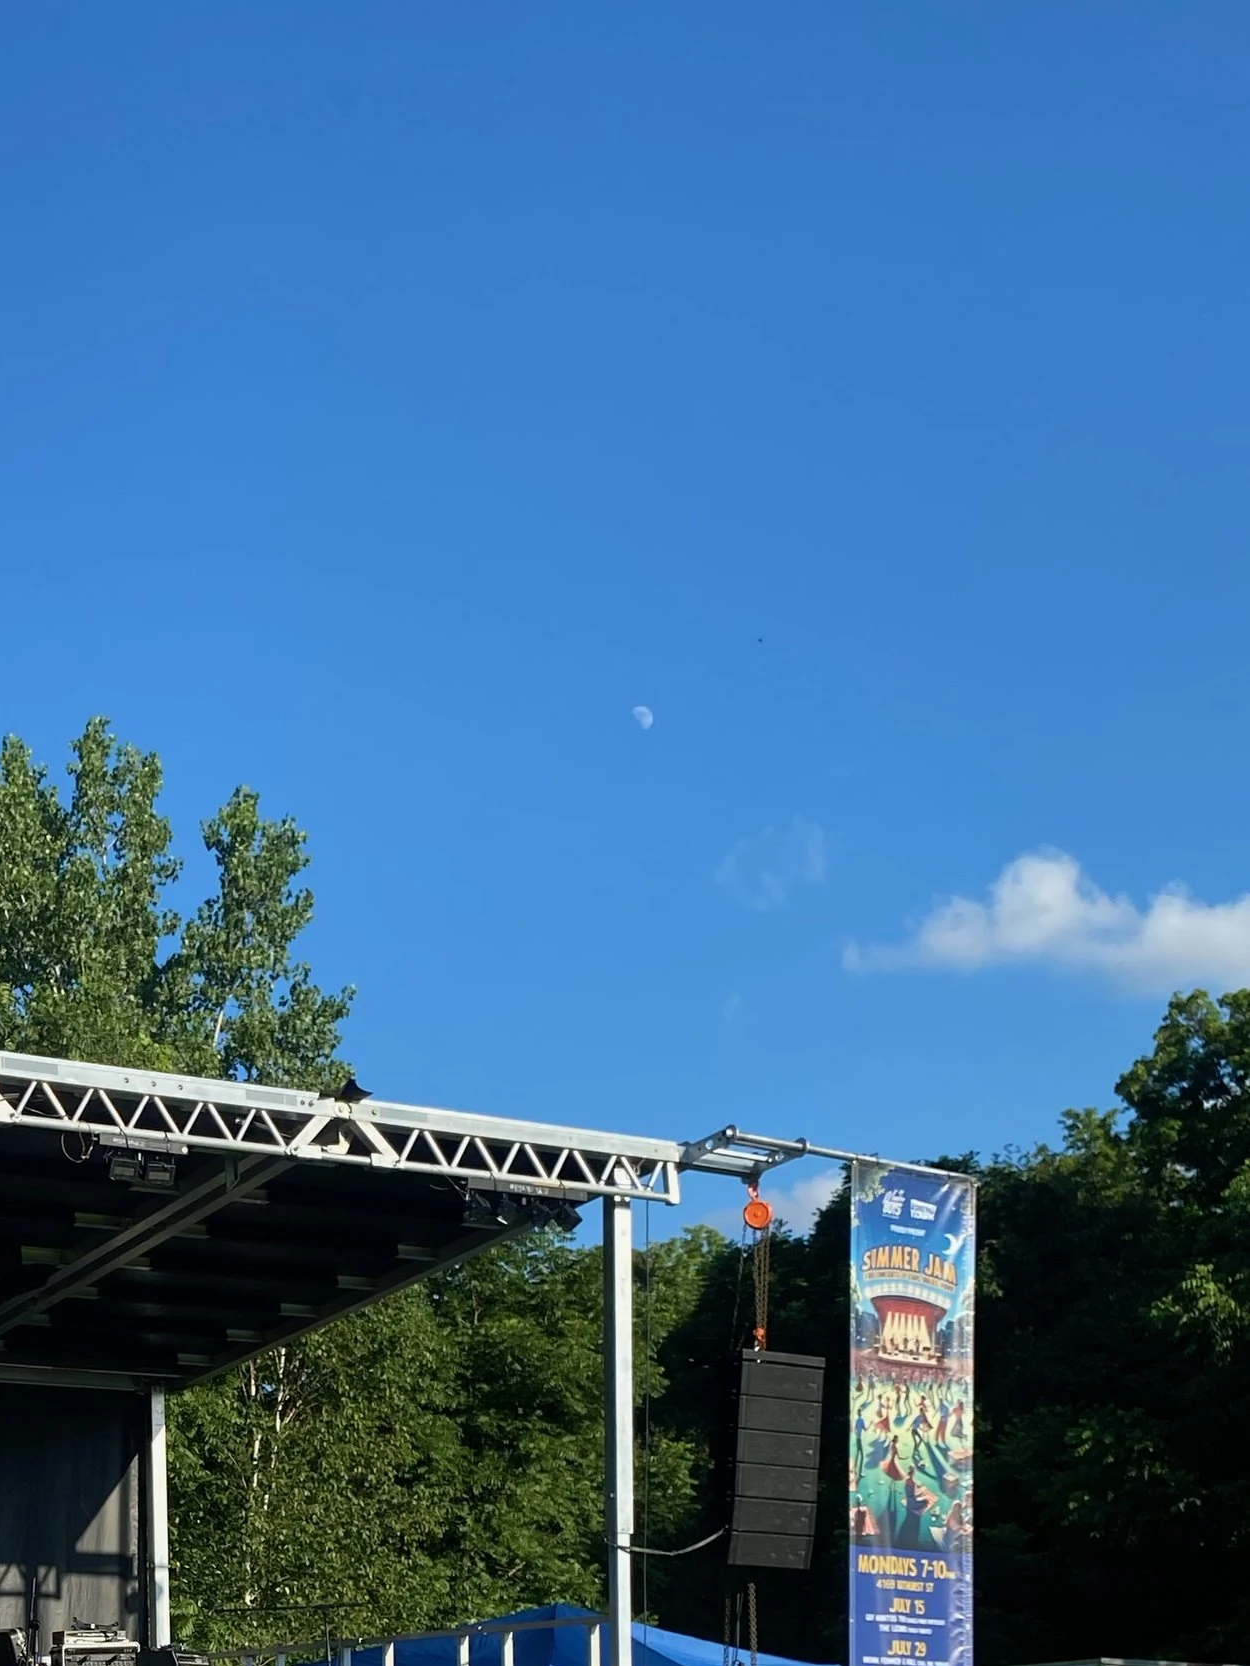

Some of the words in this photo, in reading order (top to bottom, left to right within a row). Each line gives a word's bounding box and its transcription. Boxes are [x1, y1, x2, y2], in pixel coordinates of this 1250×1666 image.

[862, 1245, 920, 1272] SUMMER
[925, 1252, 957, 1285] JAM
[858, 1554, 917, 1577] MONDAYS
[889, 1598, 911, 1613] JULY
[914, 1599, 925, 1615] 15
[888, 1640, 911, 1655] JULY
[914, 1641, 927, 1657] 29
